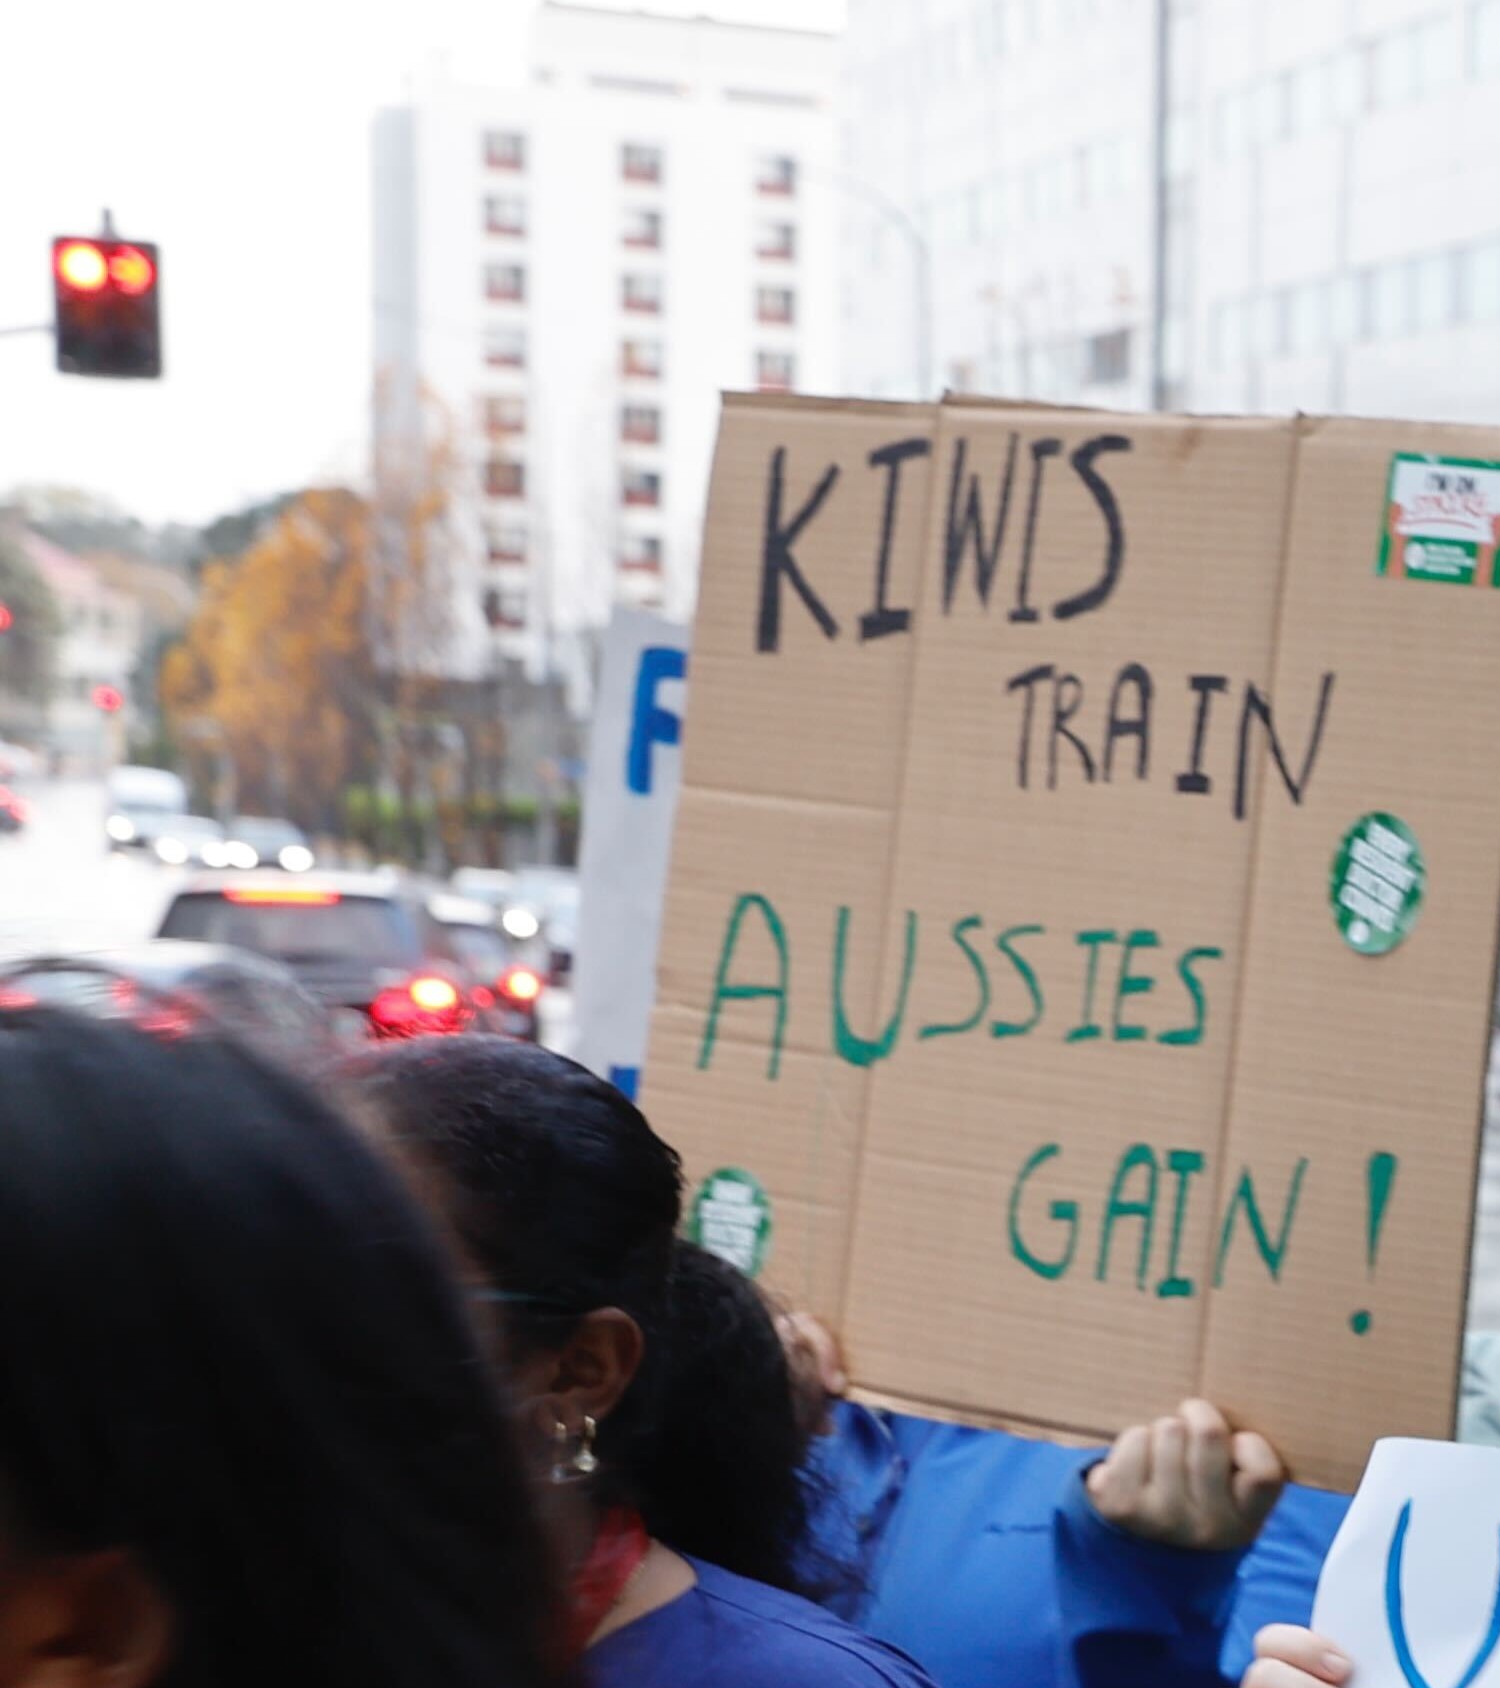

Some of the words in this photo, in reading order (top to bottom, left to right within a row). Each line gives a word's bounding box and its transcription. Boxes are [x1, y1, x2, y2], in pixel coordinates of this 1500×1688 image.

[756, 432, 1132, 653] KIWIS
[1007, 663, 1334, 821] TRAIN
[697, 893, 1224, 1081] AUSSIES
